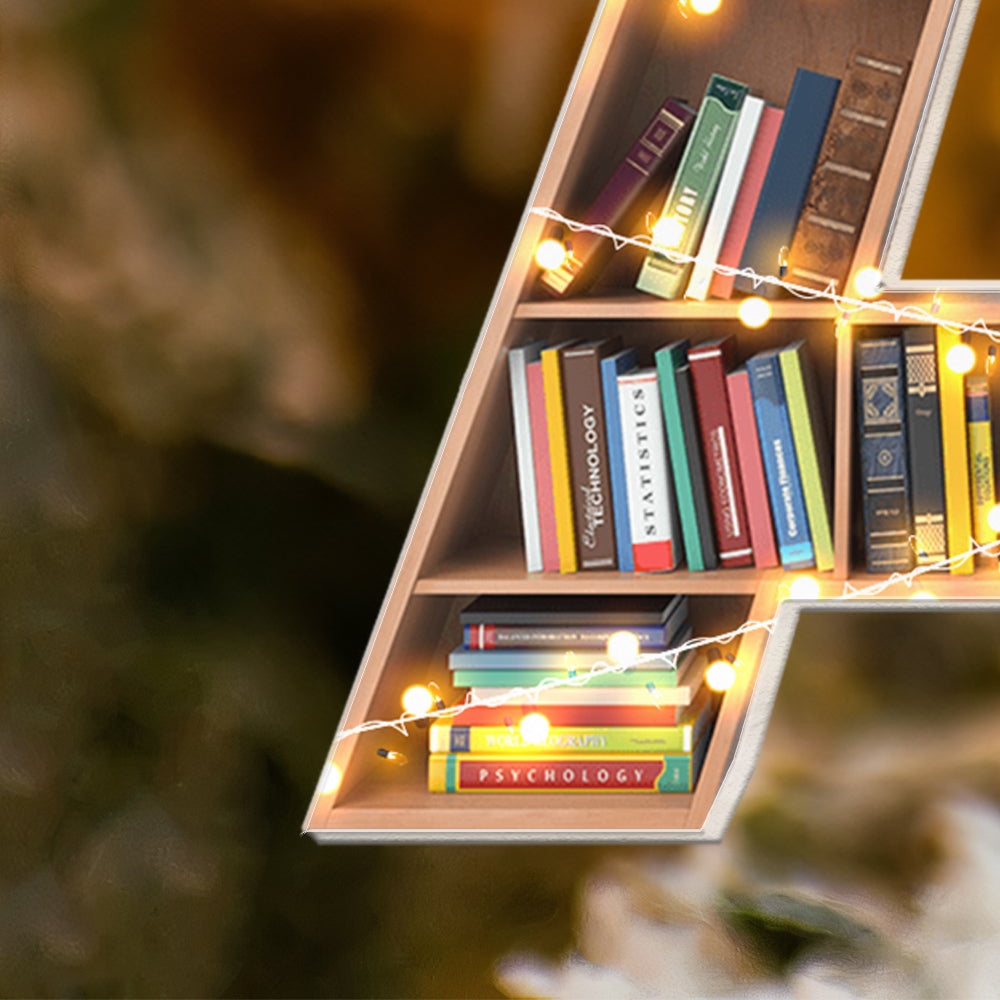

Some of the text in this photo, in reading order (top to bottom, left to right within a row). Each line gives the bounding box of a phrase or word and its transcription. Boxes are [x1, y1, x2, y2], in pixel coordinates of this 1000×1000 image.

[583, 403, 605, 526] TECHNOLOGY
[632, 388, 656, 537] STATISTICS
[479, 769, 644, 784] PSYCHOLOGY
